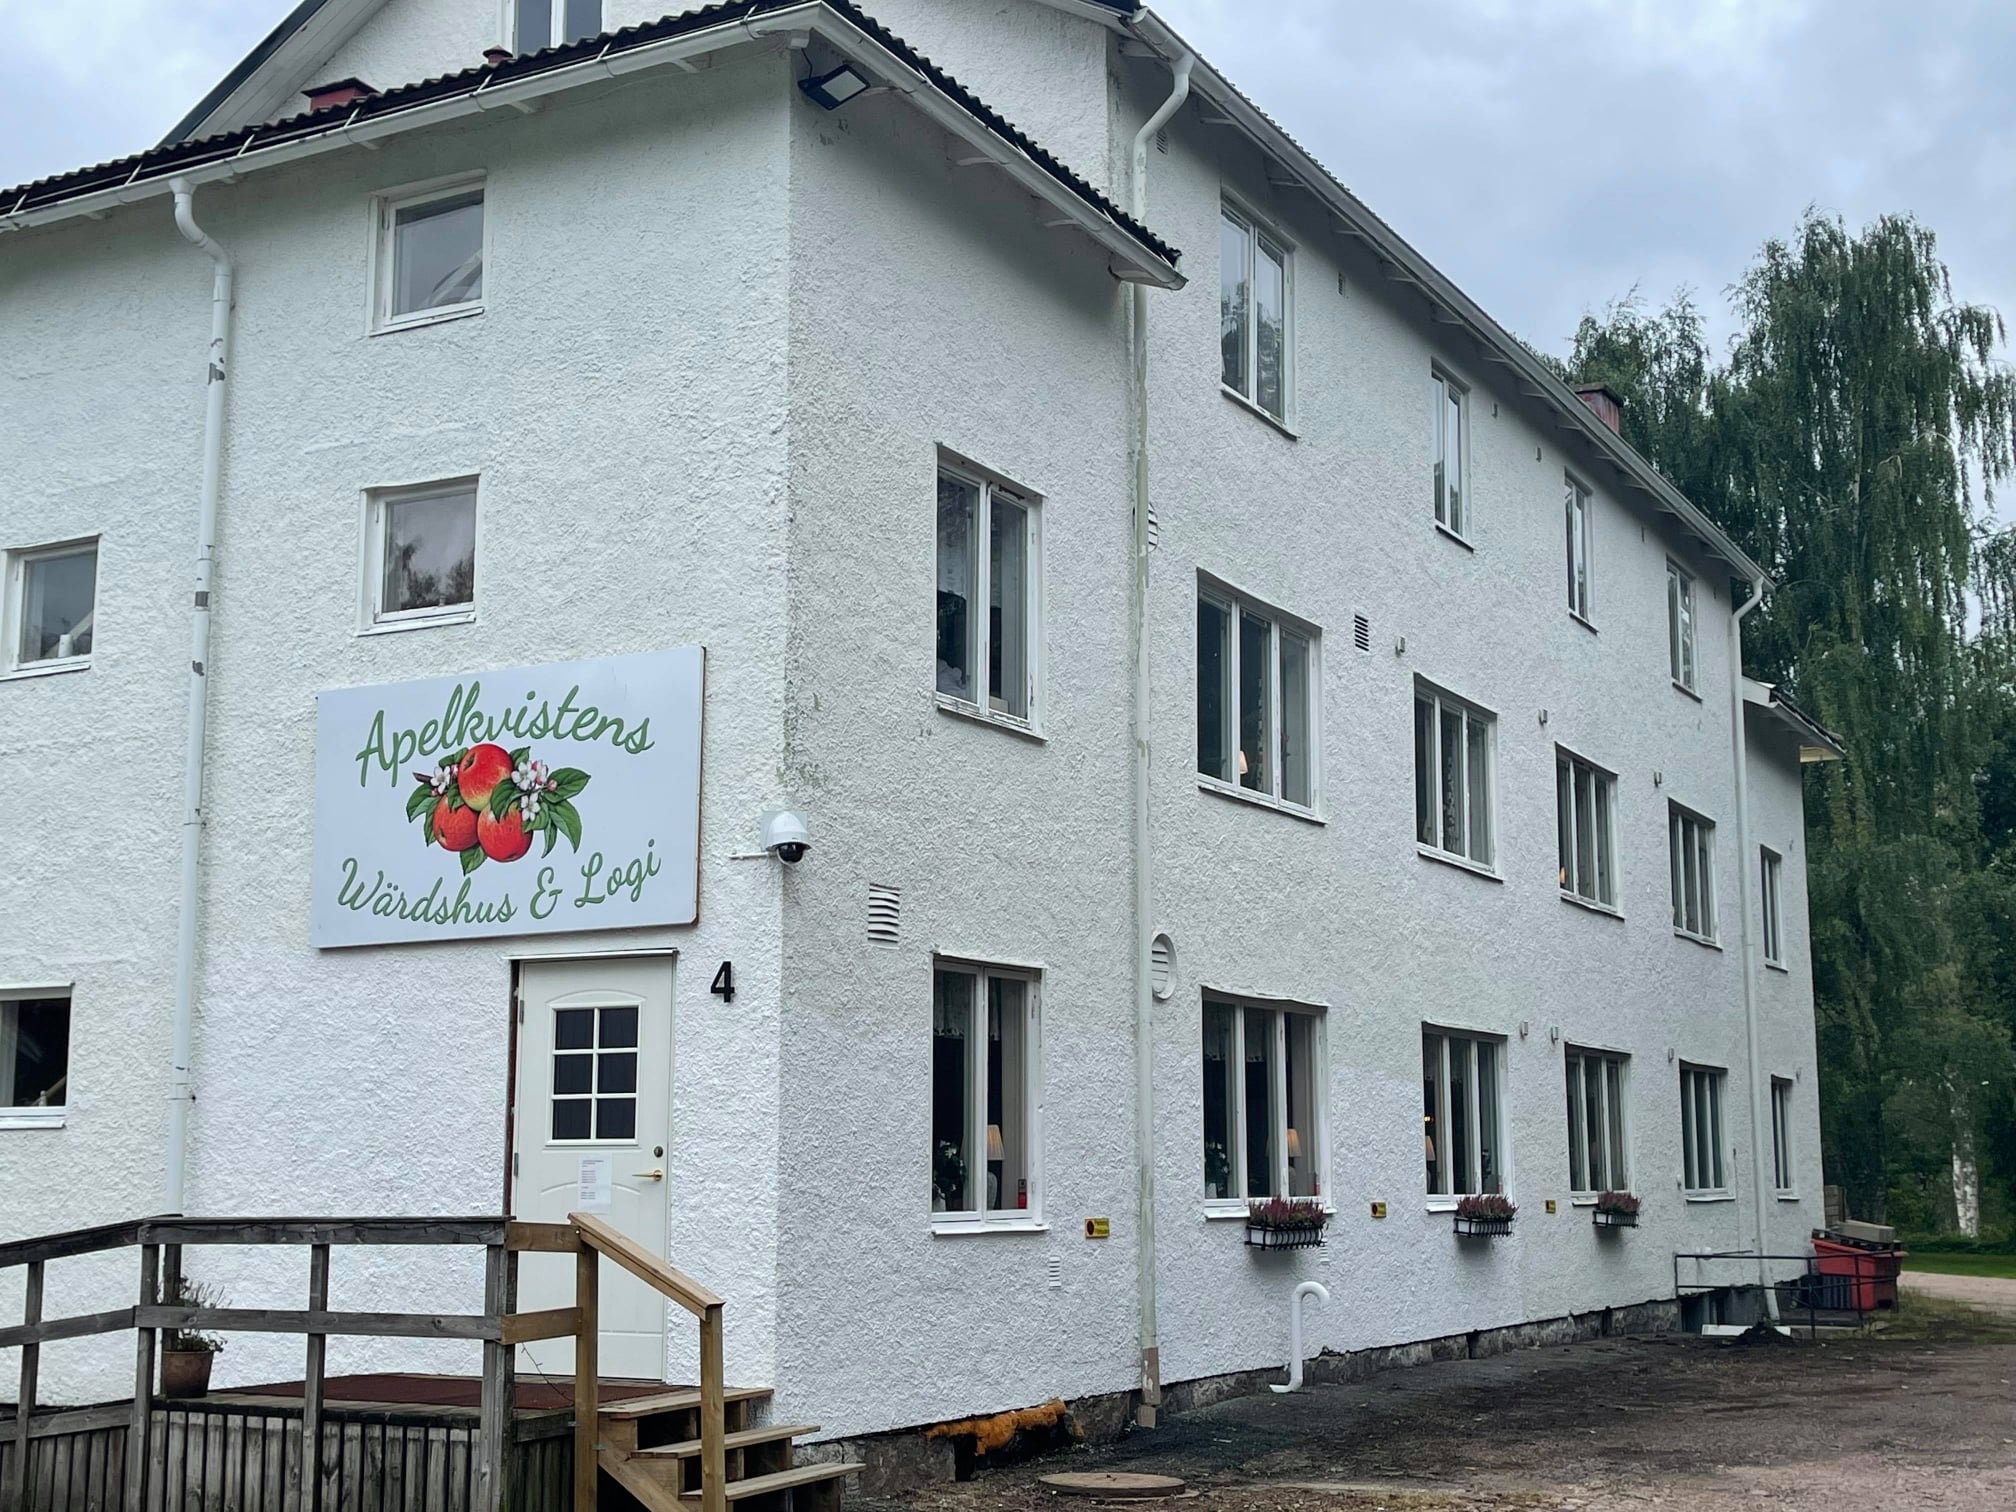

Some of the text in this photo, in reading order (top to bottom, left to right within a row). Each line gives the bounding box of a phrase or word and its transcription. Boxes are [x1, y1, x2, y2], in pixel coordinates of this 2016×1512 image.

[356, 681, 655, 787] Apelkvistens
[337, 840, 661, 924] Wärdshus & Logi
[710, 961, 735, 1002] 4
